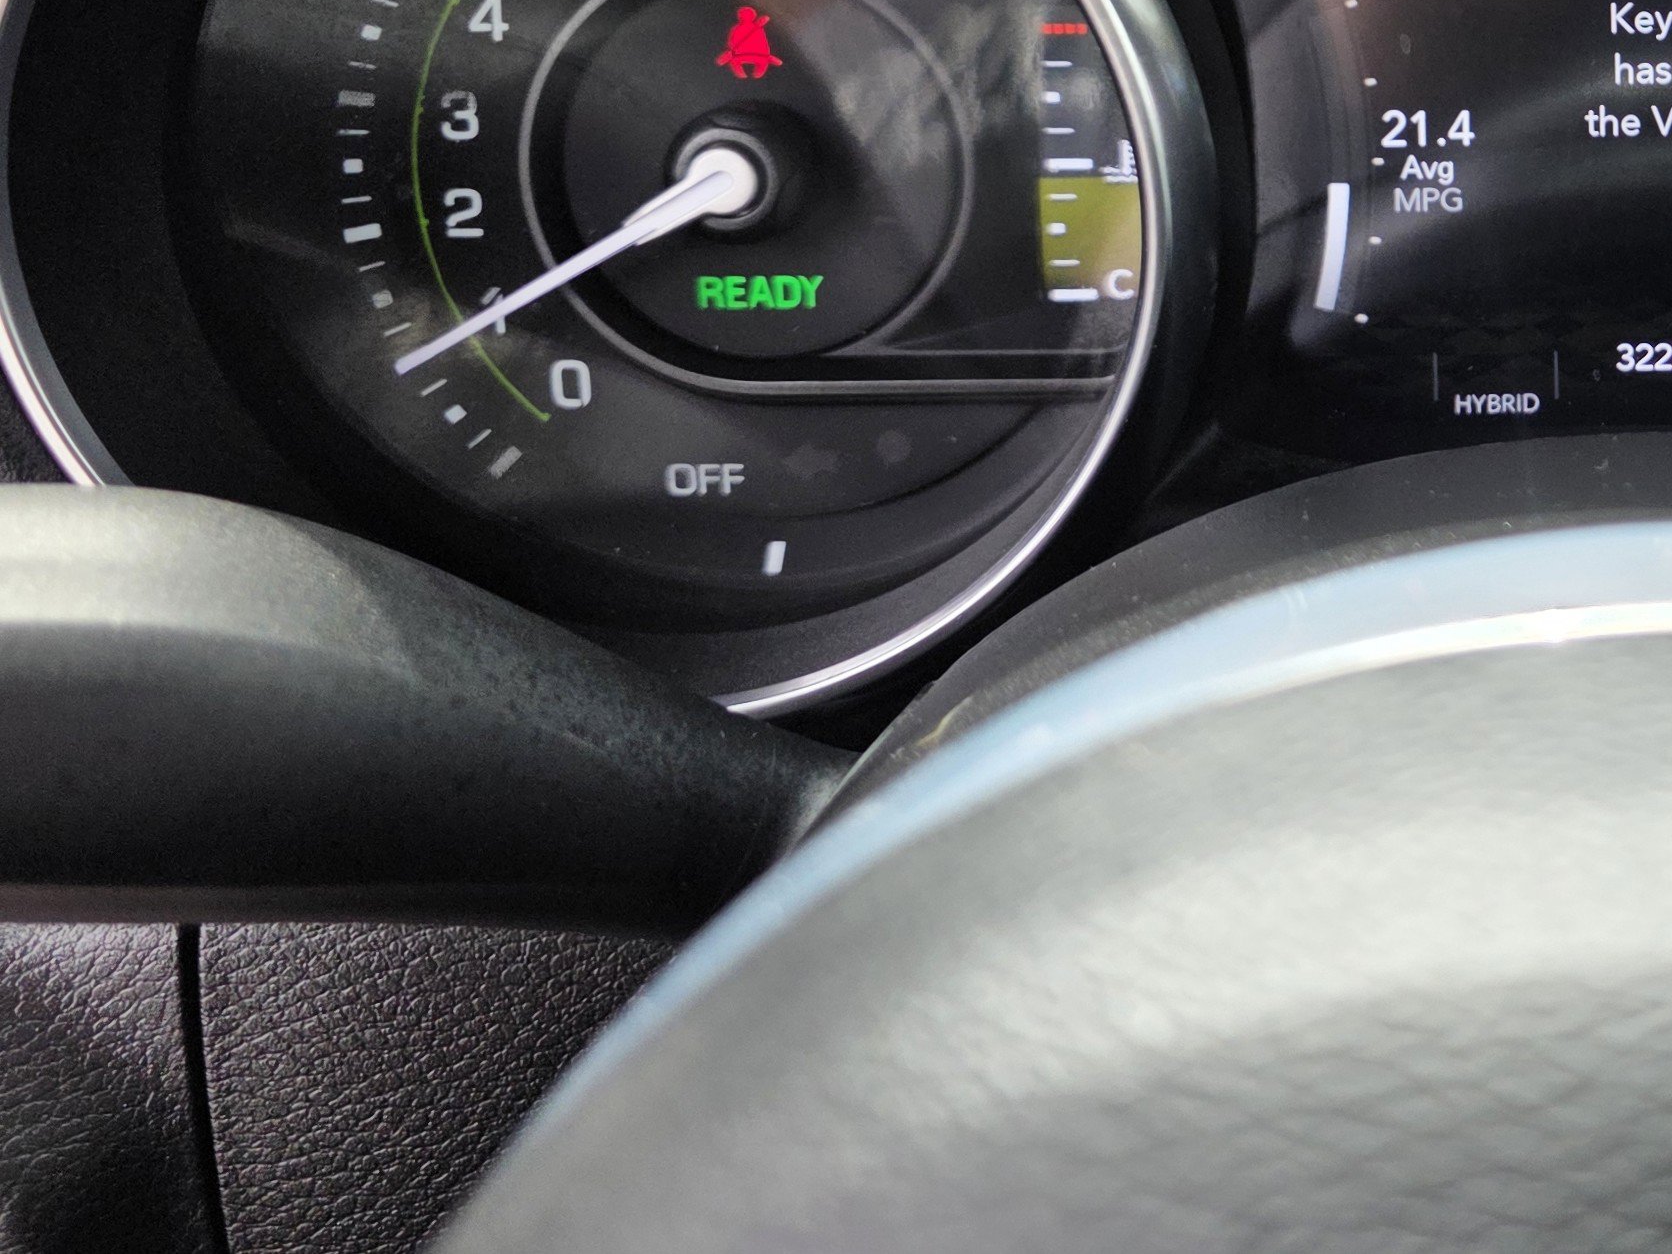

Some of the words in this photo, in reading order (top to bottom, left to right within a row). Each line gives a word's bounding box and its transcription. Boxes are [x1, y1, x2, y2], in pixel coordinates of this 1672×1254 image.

[1614, 52, 1672, 86] has
[440, 90, 480, 143] 3
[1380, 109, 1476, 149] 21.4
[1584, 104, 1641, 138] the
[1400, 154, 1455, 187] Avg
[443, 187, 485, 239] 2
[1394, 184, 1463, 214] MPG
[697, 274, 824, 310] READY
[1103, 268, 1135, 300] C
[550, 359, 592, 409] 0
[1454, 392, 1541, 415] HYBRID
[665, 462, 745, 497] OFF
